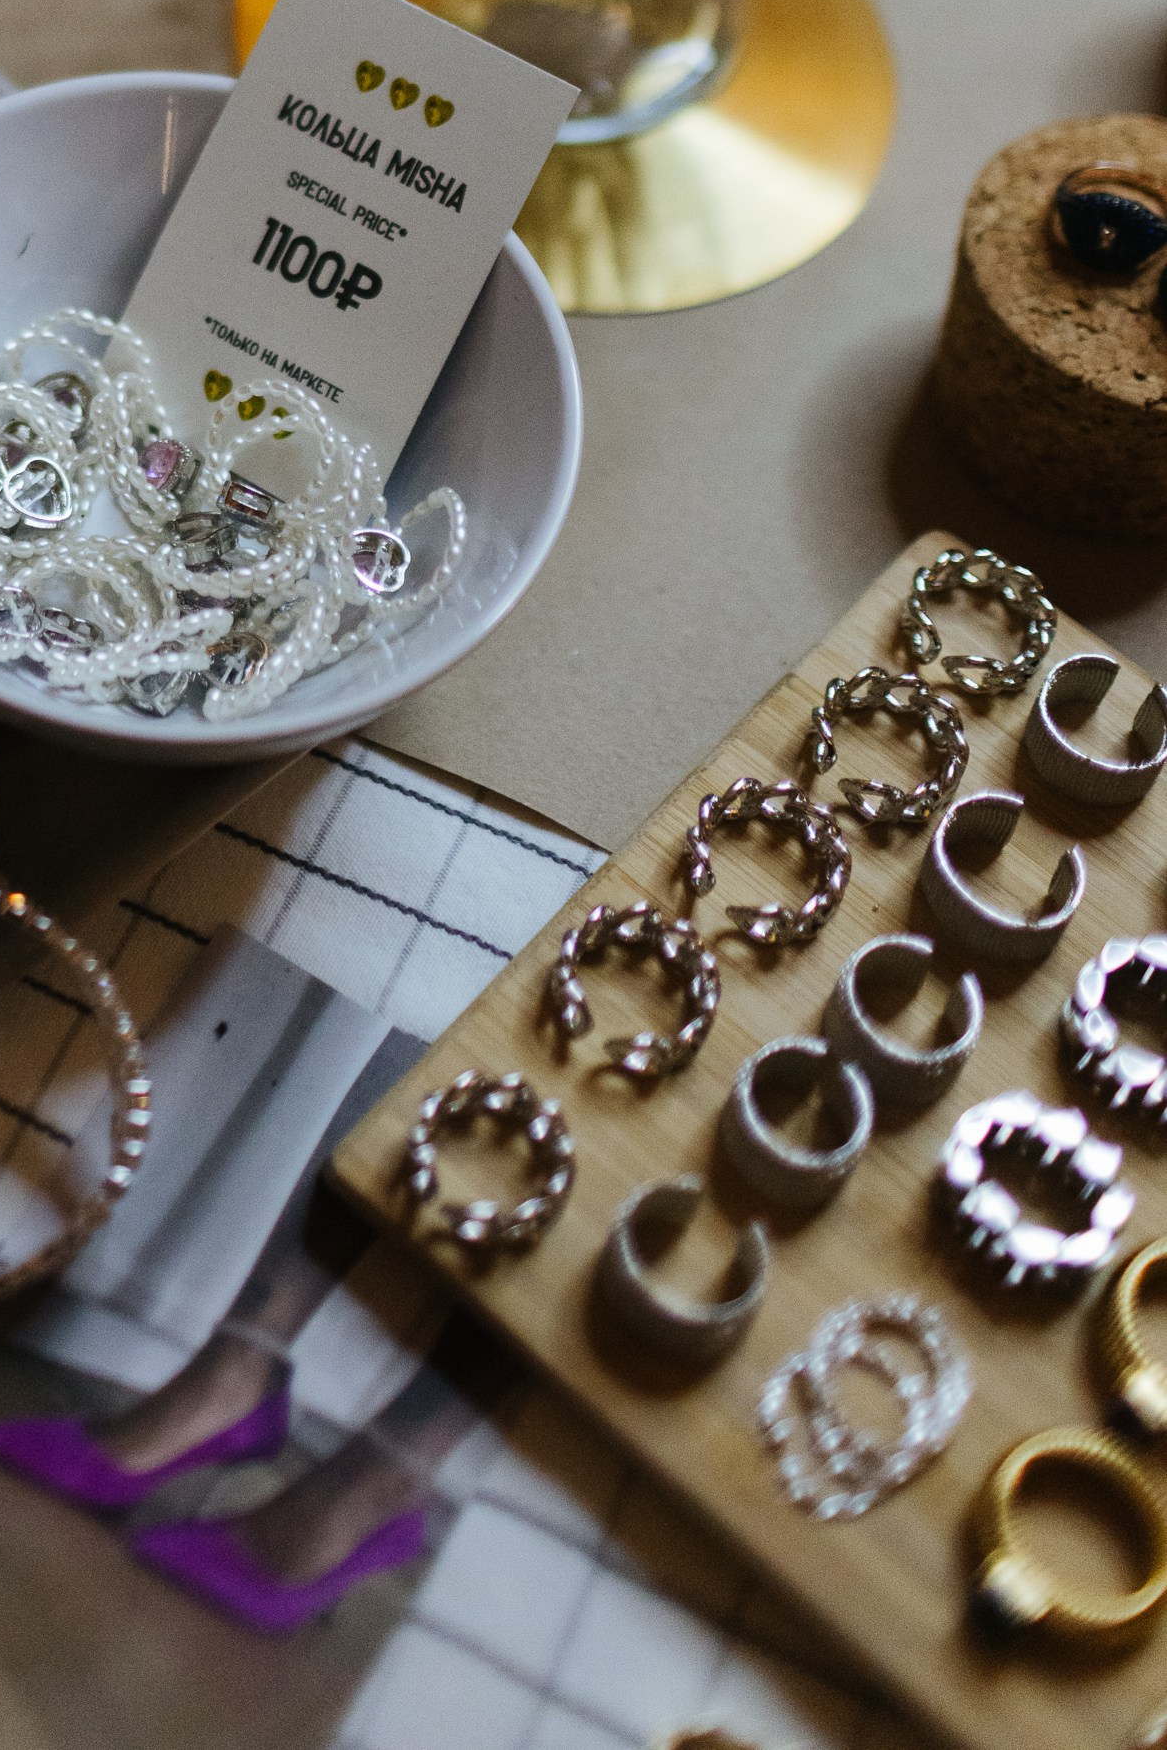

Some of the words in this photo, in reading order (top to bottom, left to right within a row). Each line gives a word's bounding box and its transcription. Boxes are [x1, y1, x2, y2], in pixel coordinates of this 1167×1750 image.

[276, 93, 383, 170] КОЛЬЦА
[383, 149, 468, 214] MISHA
[286, 170, 347, 216] SPECIAL
[251, 216, 384, 312] 1100₽
[259, 348, 279, 368] НА
[280, 359, 344, 404] МАРКЕТЕ
